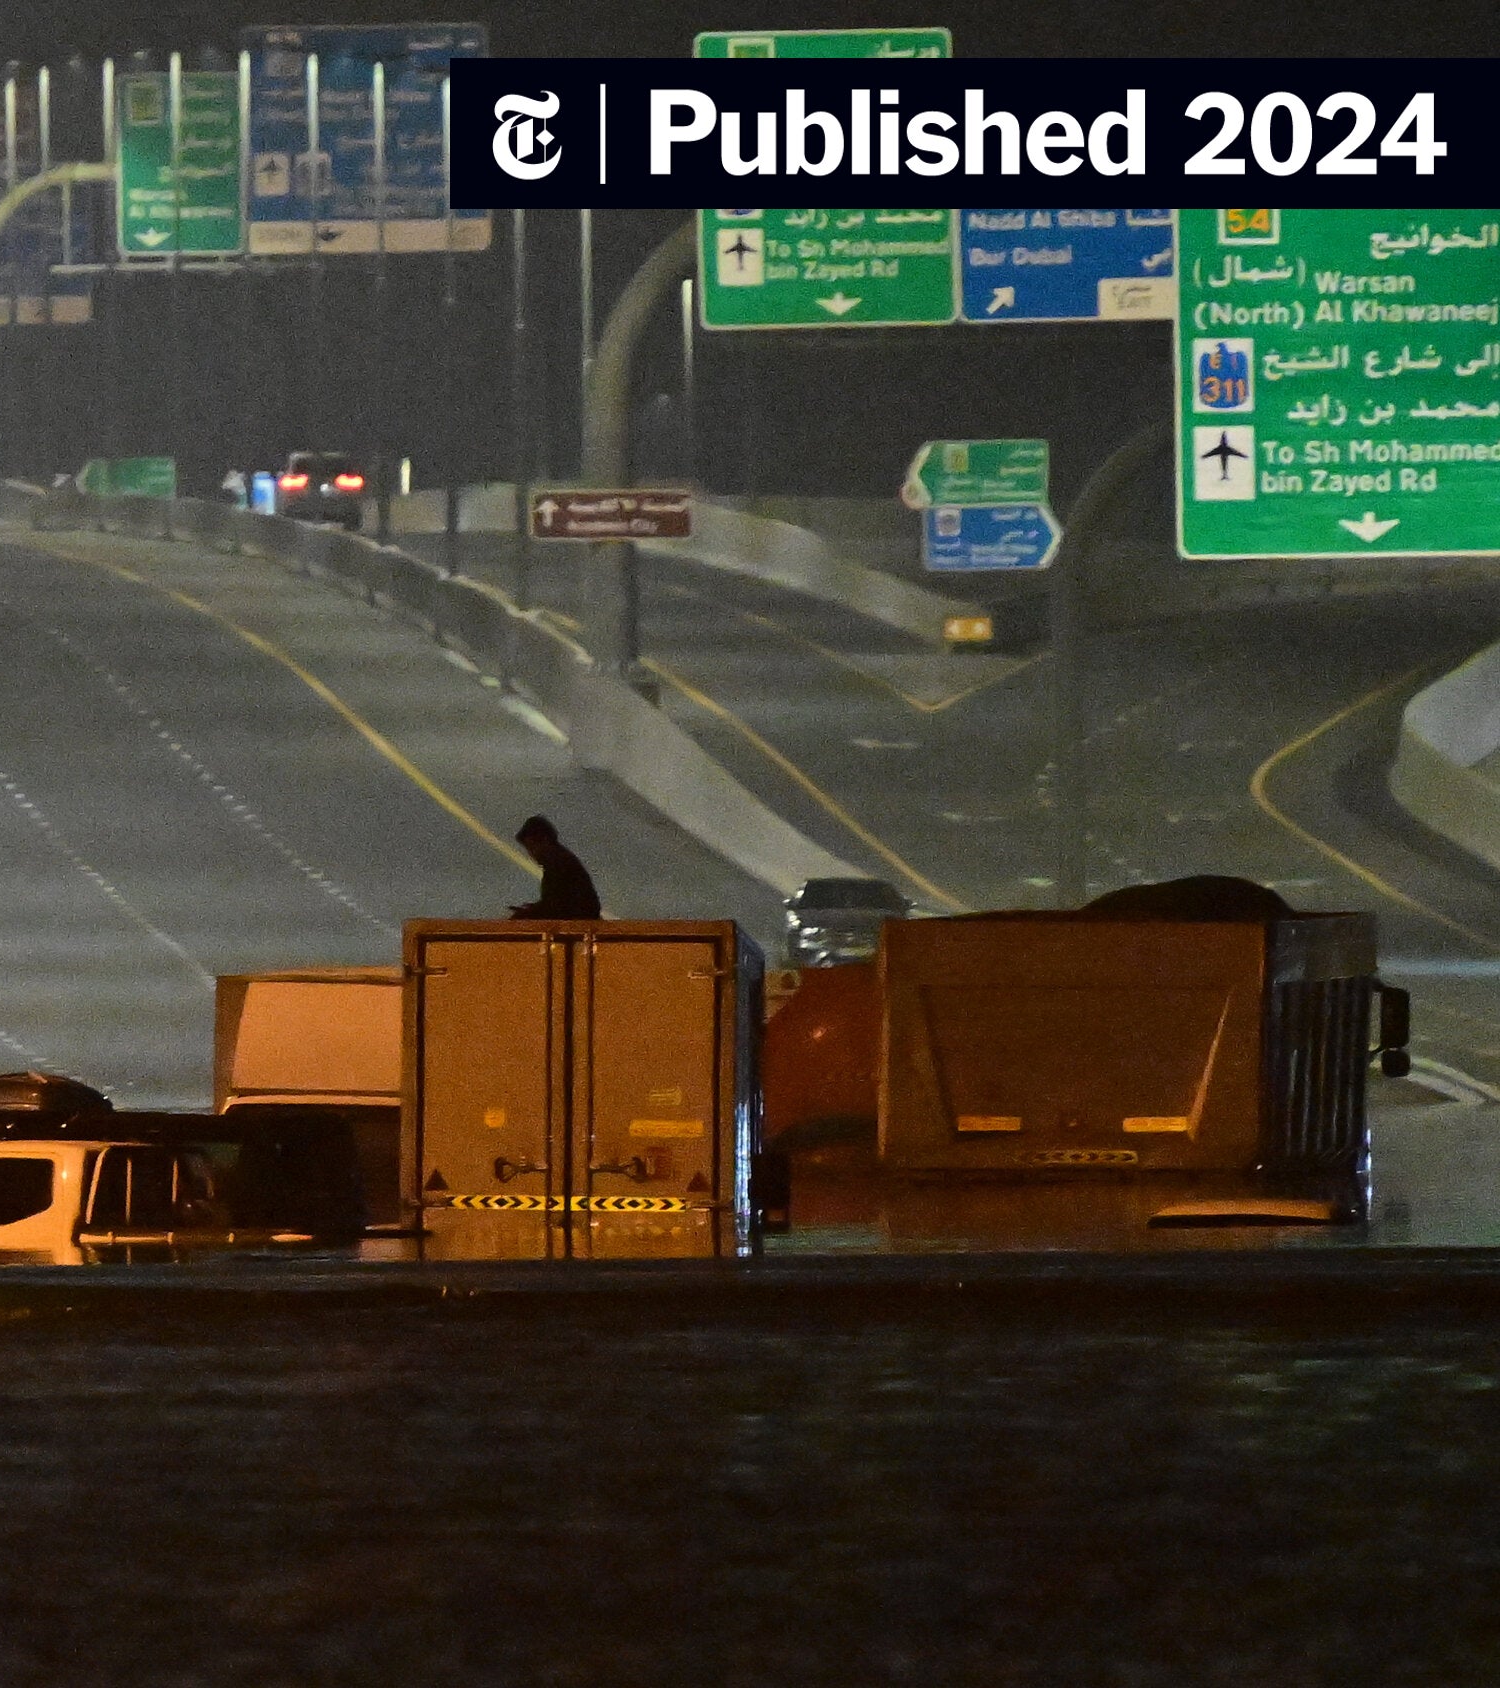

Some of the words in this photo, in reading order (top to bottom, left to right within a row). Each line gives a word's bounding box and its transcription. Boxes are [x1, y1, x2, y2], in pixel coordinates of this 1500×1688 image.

[1227, 209, 1271, 234] 54
[765, 239, 791, 257] To
[804, 260, 867, 281] Zayed
[870, 259, 900, 277] Rd
[1315, 271, 1416, 294] Warsan
[1194, 301, 1305, 330] (North)
[1315, 300, 1344, 322] Al
[1351, 297, 1500, 325] Khawaneej
[1263, 344, 1350, 381] الشيخ
[1364, 344, 1442, 379] شارع
[1200, 376, 1247, 404] 311
[1287, 394, 1347, 426] زايد
[1359, 399, 1396, 426] بن
[1409, 399, 1500, 420] محمد
[1262, 441, 1294, 464] To
[1305, 440, 1340, 463] Sh
[1262, 471, 1303, 493] bin
[1311, 469, 1391, 496] Zayed
[1400, 468, 1437, 492] Rd
